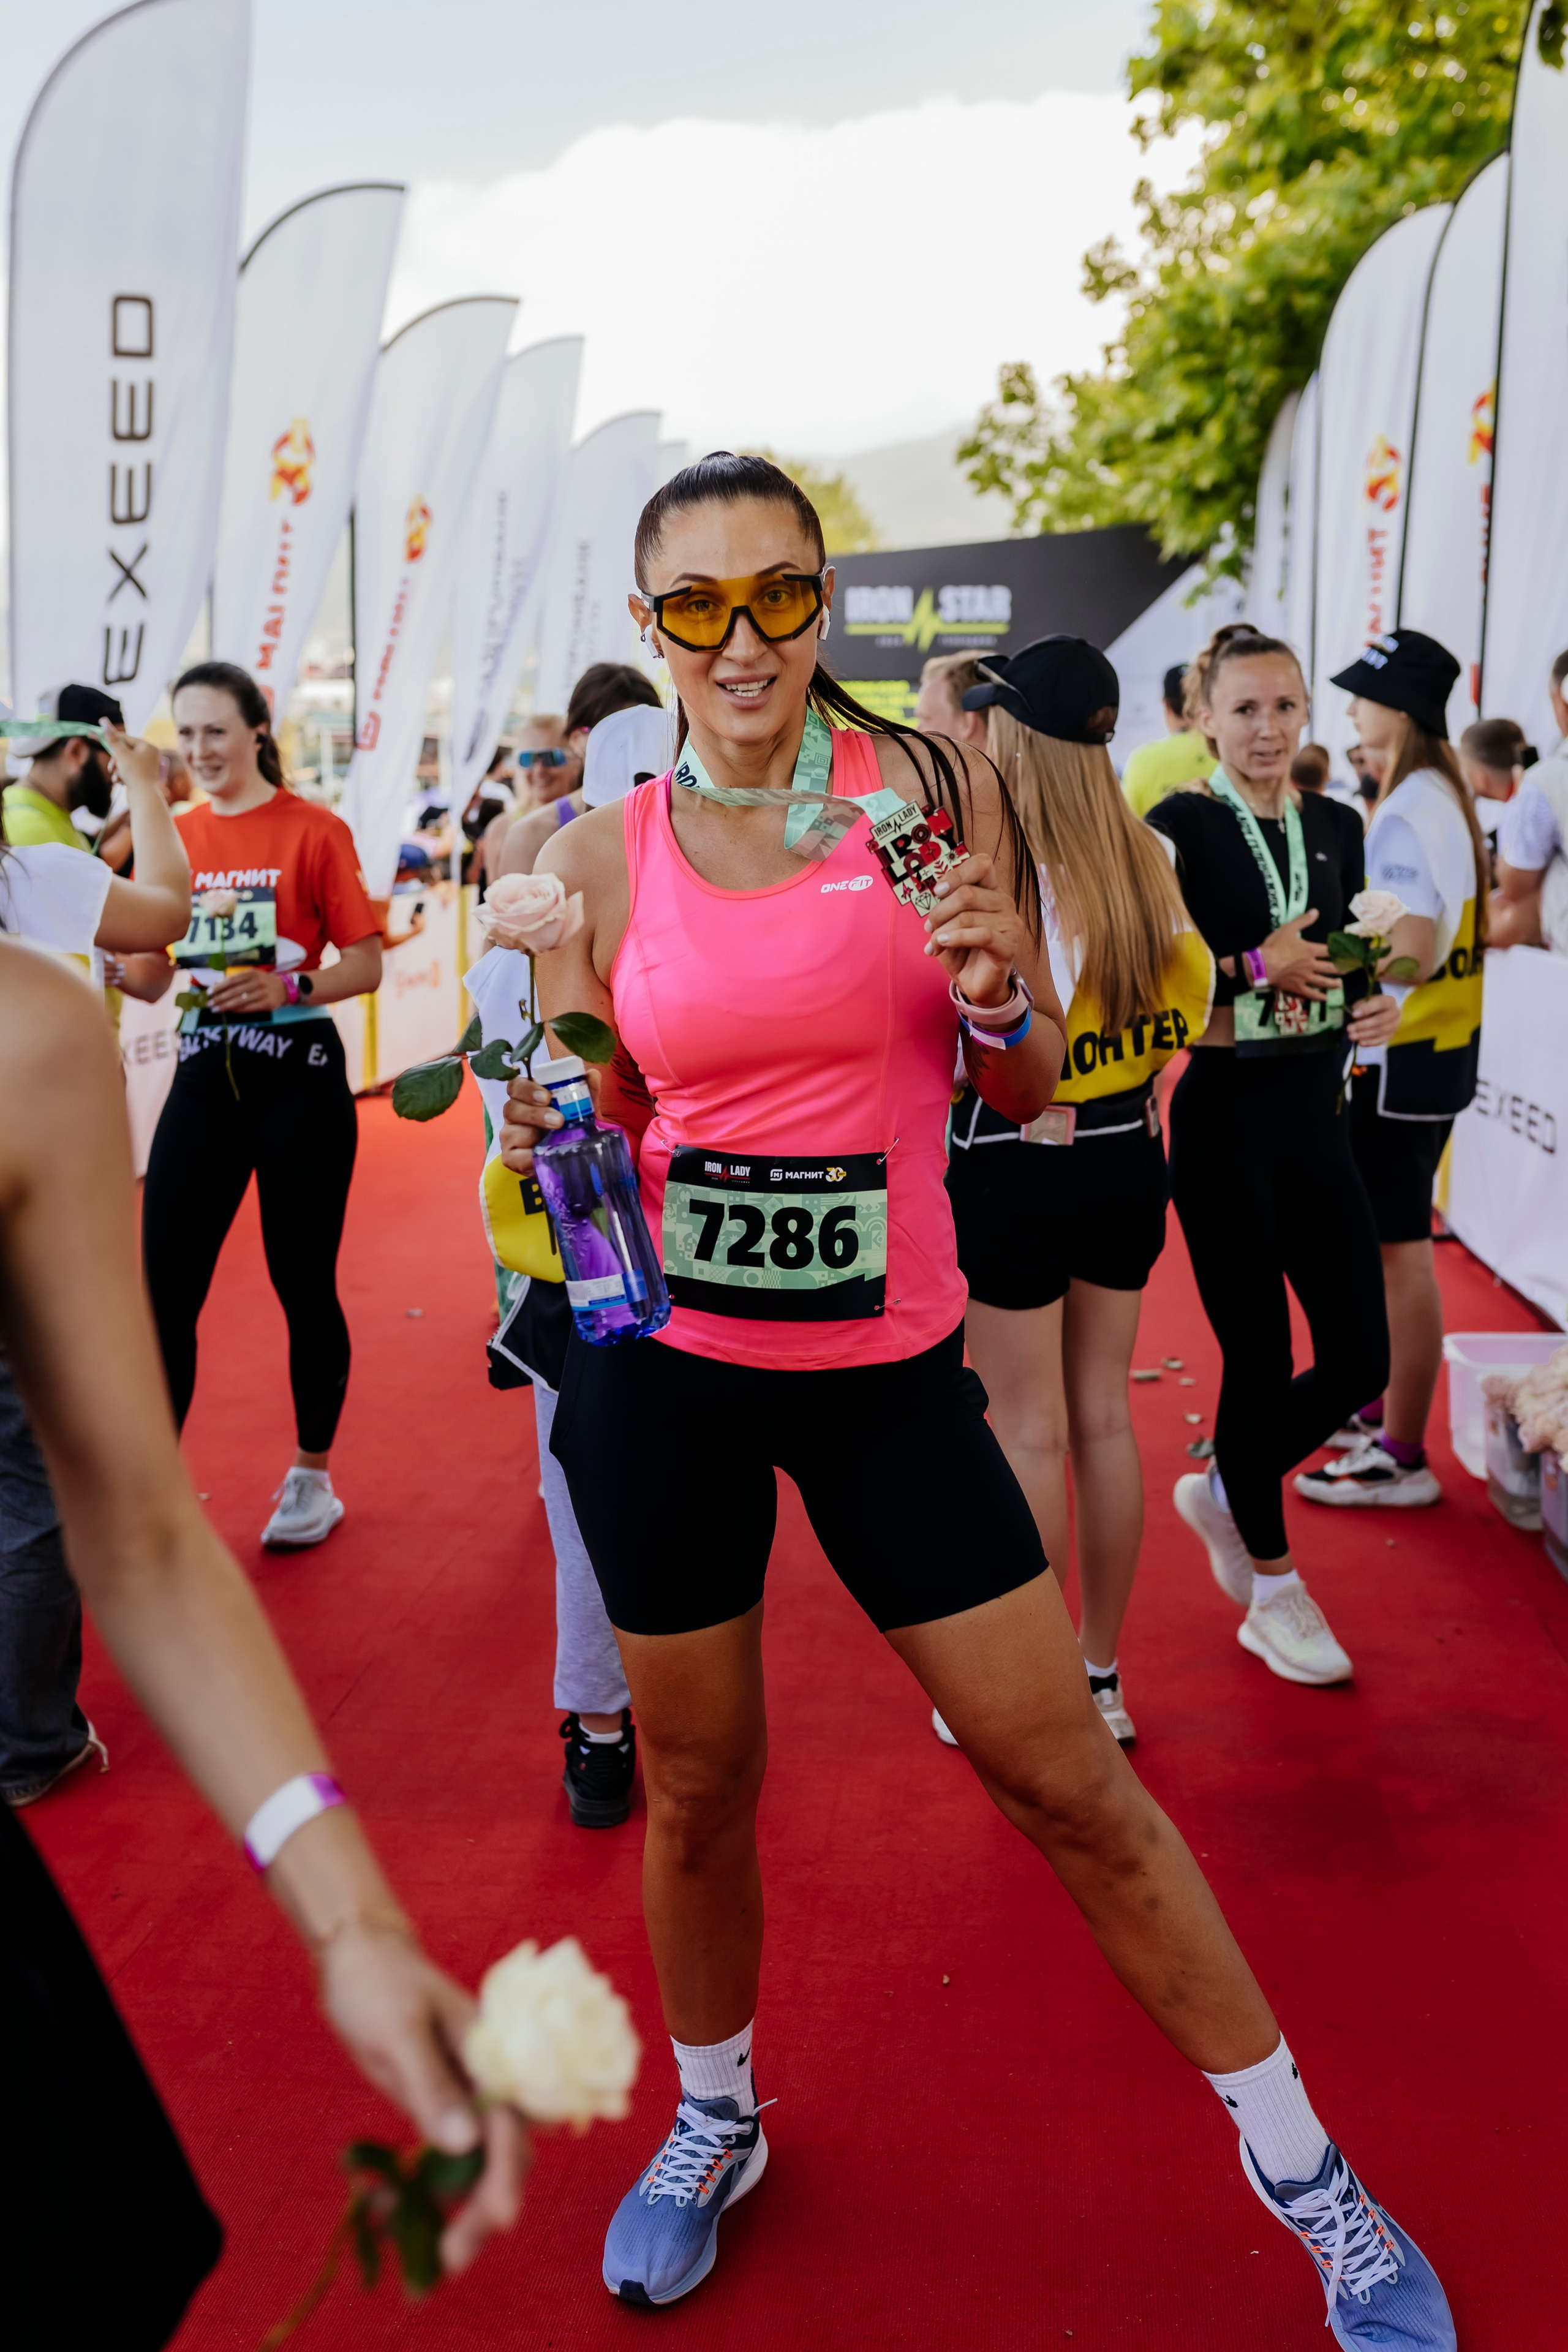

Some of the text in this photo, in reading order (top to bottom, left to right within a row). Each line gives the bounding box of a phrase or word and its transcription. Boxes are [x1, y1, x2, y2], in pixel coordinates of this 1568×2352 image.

[104, 294, 154, 686] EXEED
[938, 584, 1012, 624] STAR
[674, 761, 700, 788] IRO
[874, 804, 918, 837] IRON LADY
[195, 869, 282, 889] МАГНИТ
[704, 1161, 751, 1177] IRON LADY
[689, 1198, 859, 1270] 7286
